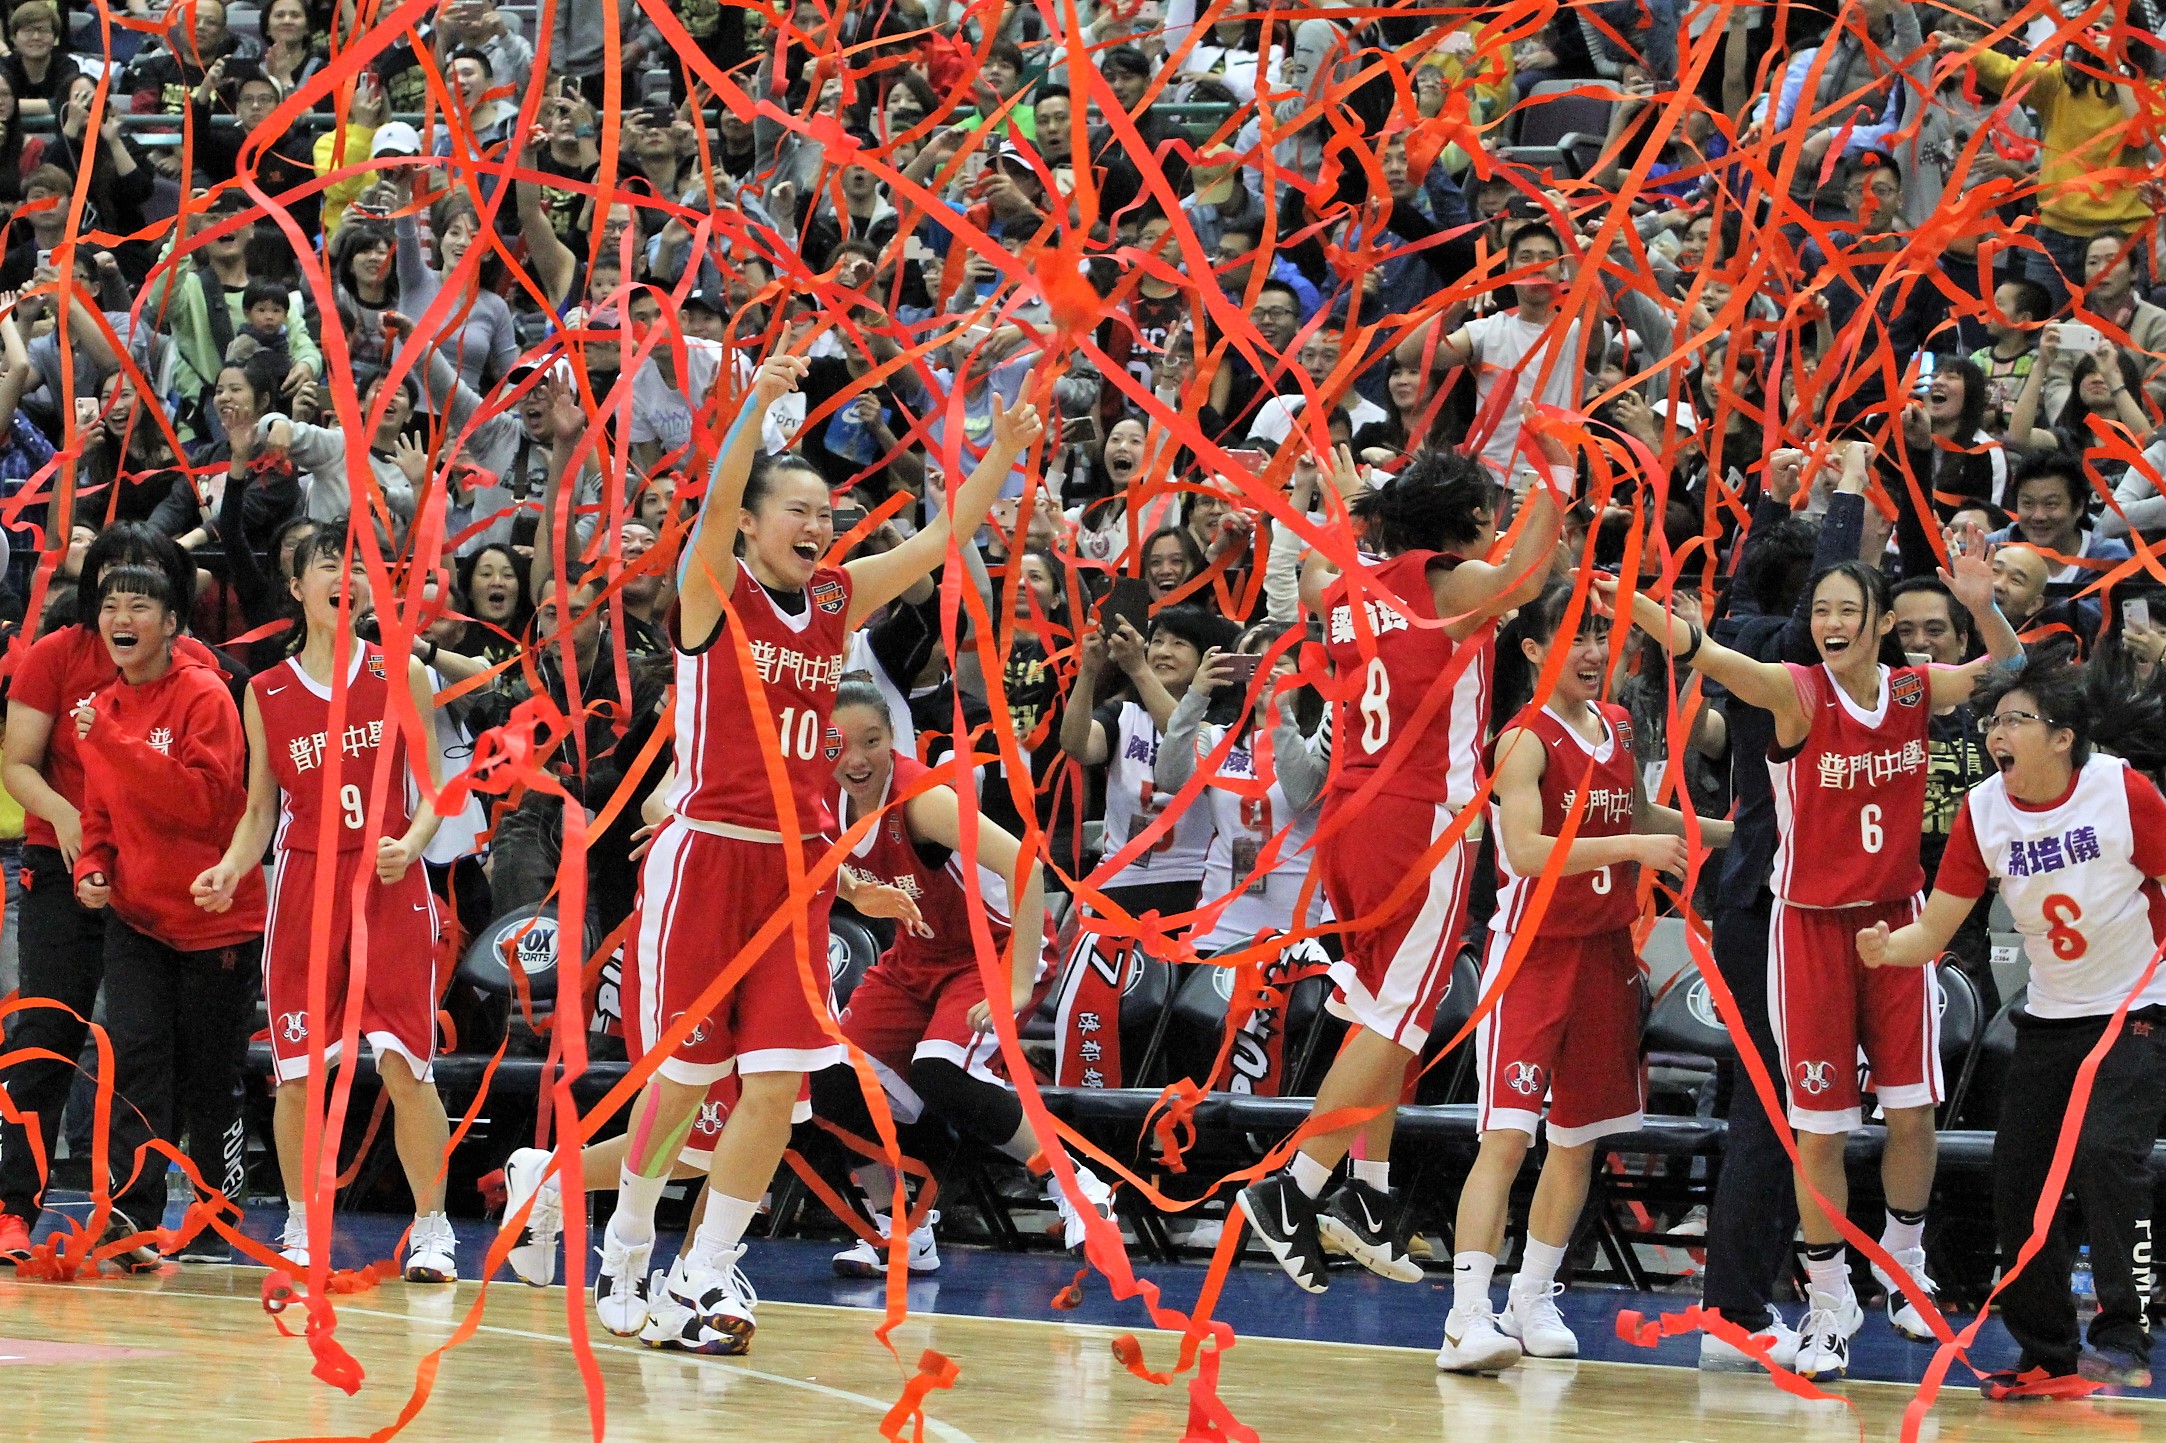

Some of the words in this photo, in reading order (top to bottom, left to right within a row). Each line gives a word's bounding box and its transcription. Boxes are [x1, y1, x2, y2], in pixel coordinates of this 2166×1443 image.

[1360, 657, 1390, 755] 8
[779, 707, 819, 760] 10
[1817, 738, 1926, 789] 普門中學
[340, 784, 364, 829] 9
[1860, 803, 1884, 854] 6
[516, 928, 556, 952] OX
[517, 952, 551, 962] PORTS
